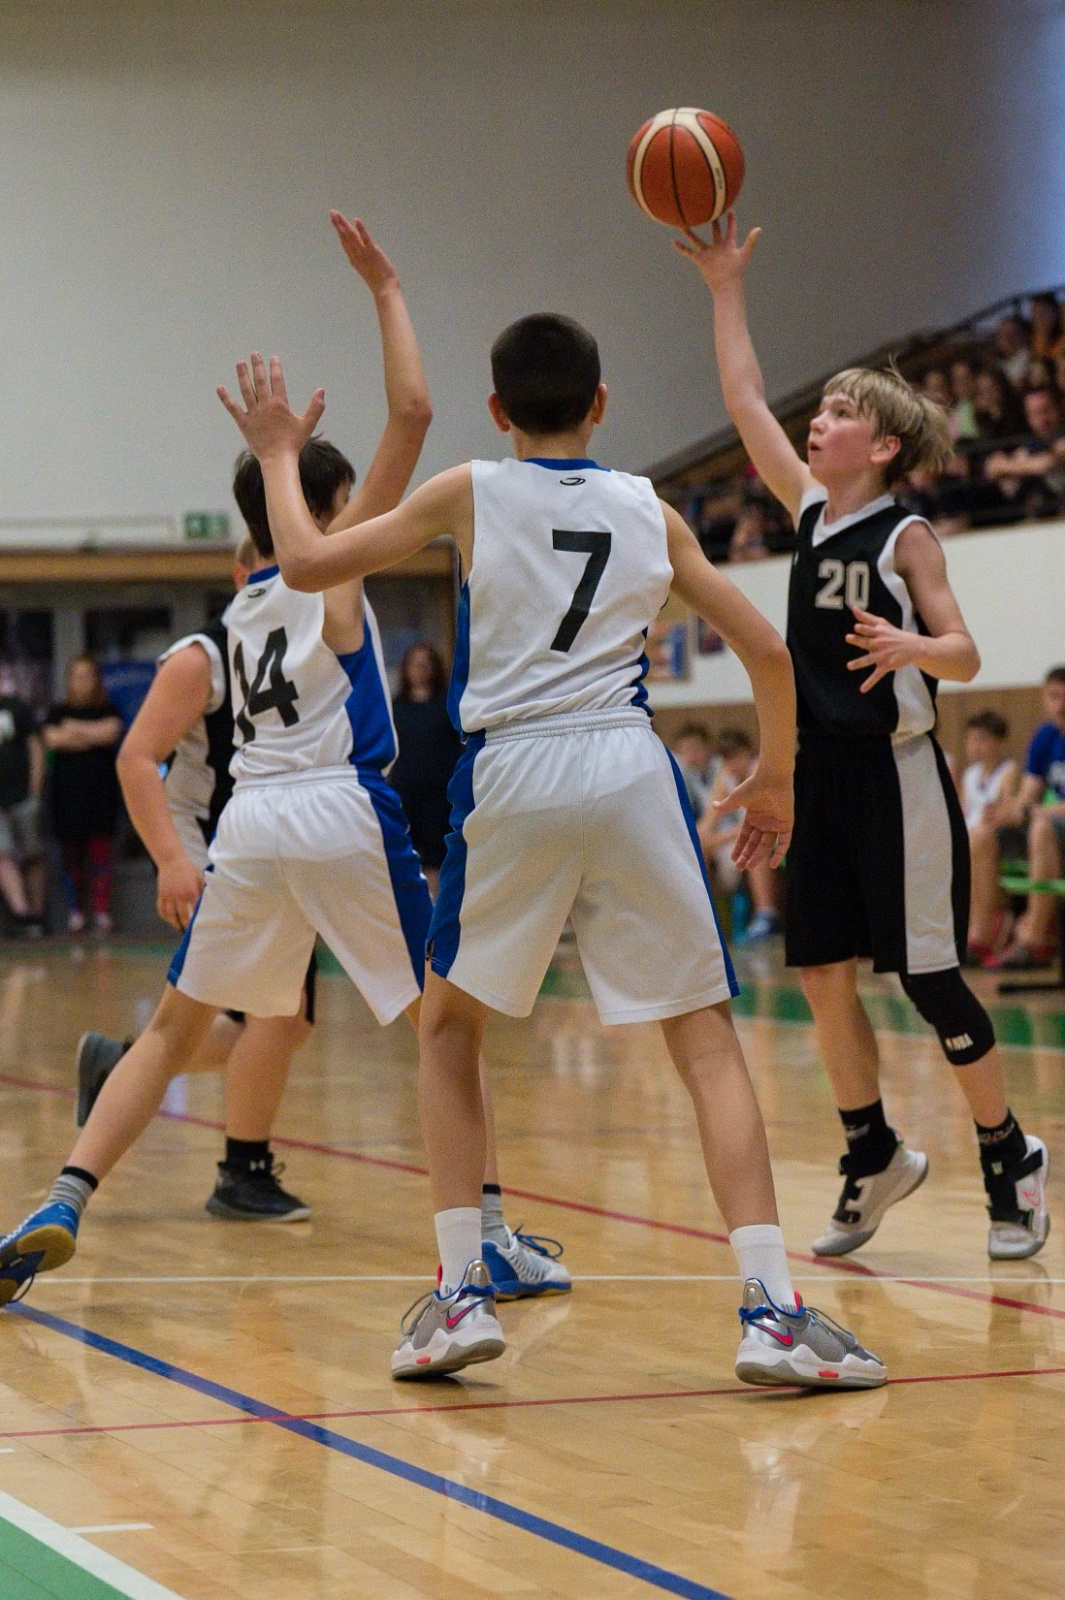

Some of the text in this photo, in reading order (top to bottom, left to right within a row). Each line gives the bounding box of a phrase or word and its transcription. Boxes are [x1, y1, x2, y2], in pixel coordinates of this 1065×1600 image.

[550, 529, 612, 652] 7
[815, 558, 870, 611] 20
[233, 626, 299, 743] 14
